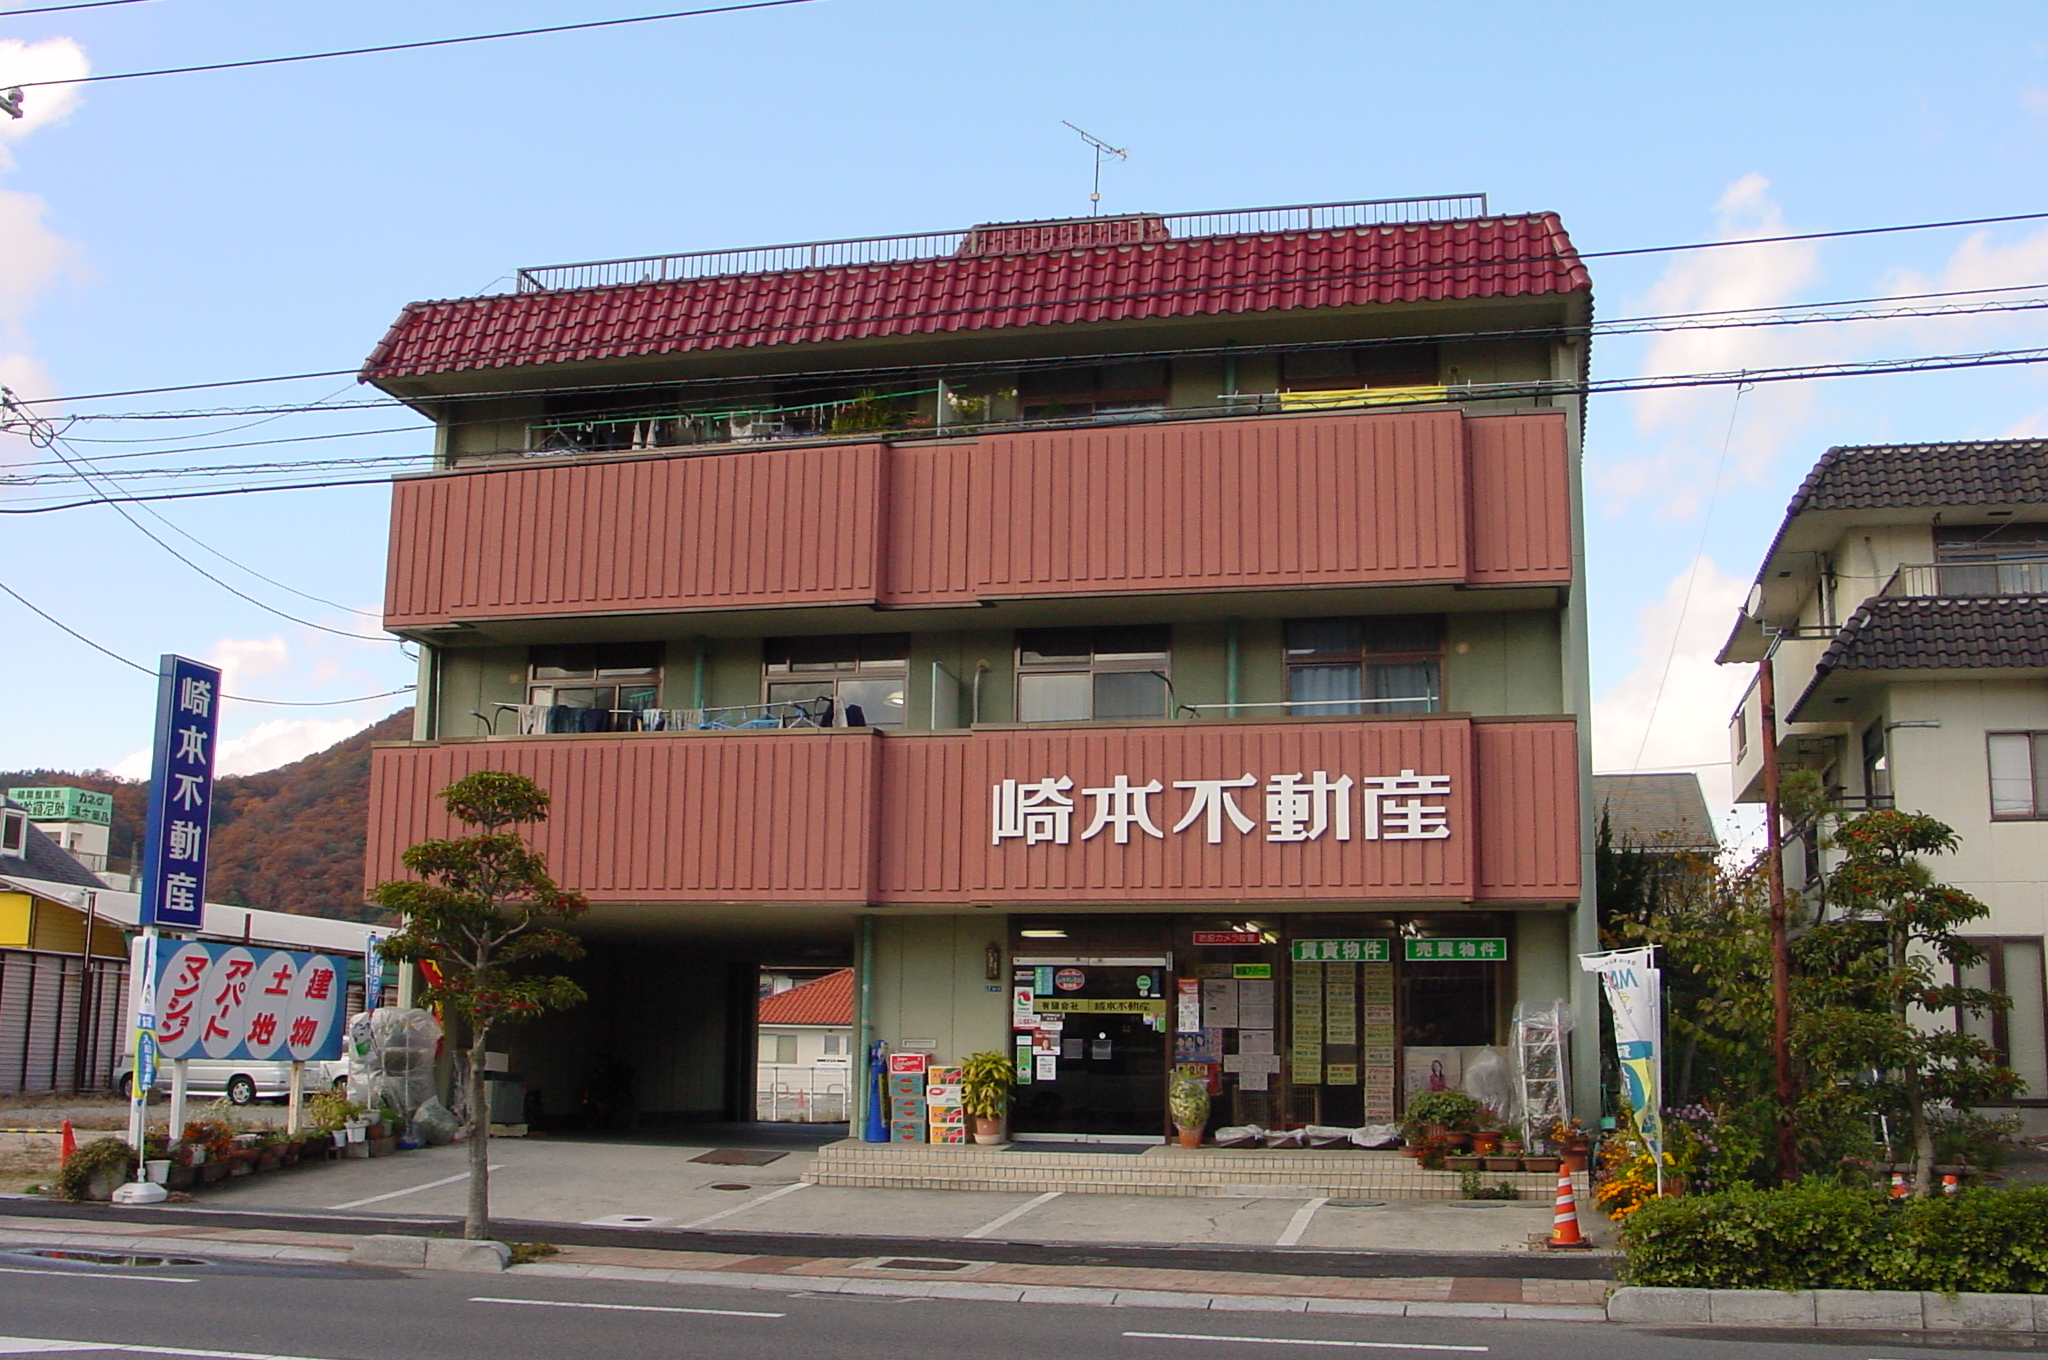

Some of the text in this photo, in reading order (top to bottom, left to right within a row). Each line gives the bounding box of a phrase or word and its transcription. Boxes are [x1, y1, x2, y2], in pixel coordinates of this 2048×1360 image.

[164, 677, 212, 912] 崎本不動産
[992, 769, 1450, 845] 崎本不動産
[1301, 941, 1381, 959] 賃貸物件
[1416, 942, 1497, 957] 売買物件
[158, 956, 210, 1043] マンション
[203, 959, 254, 1040] アパート
[247, 964, 290, 1045] 土地
[290, 968, 333, 1047] 建物
